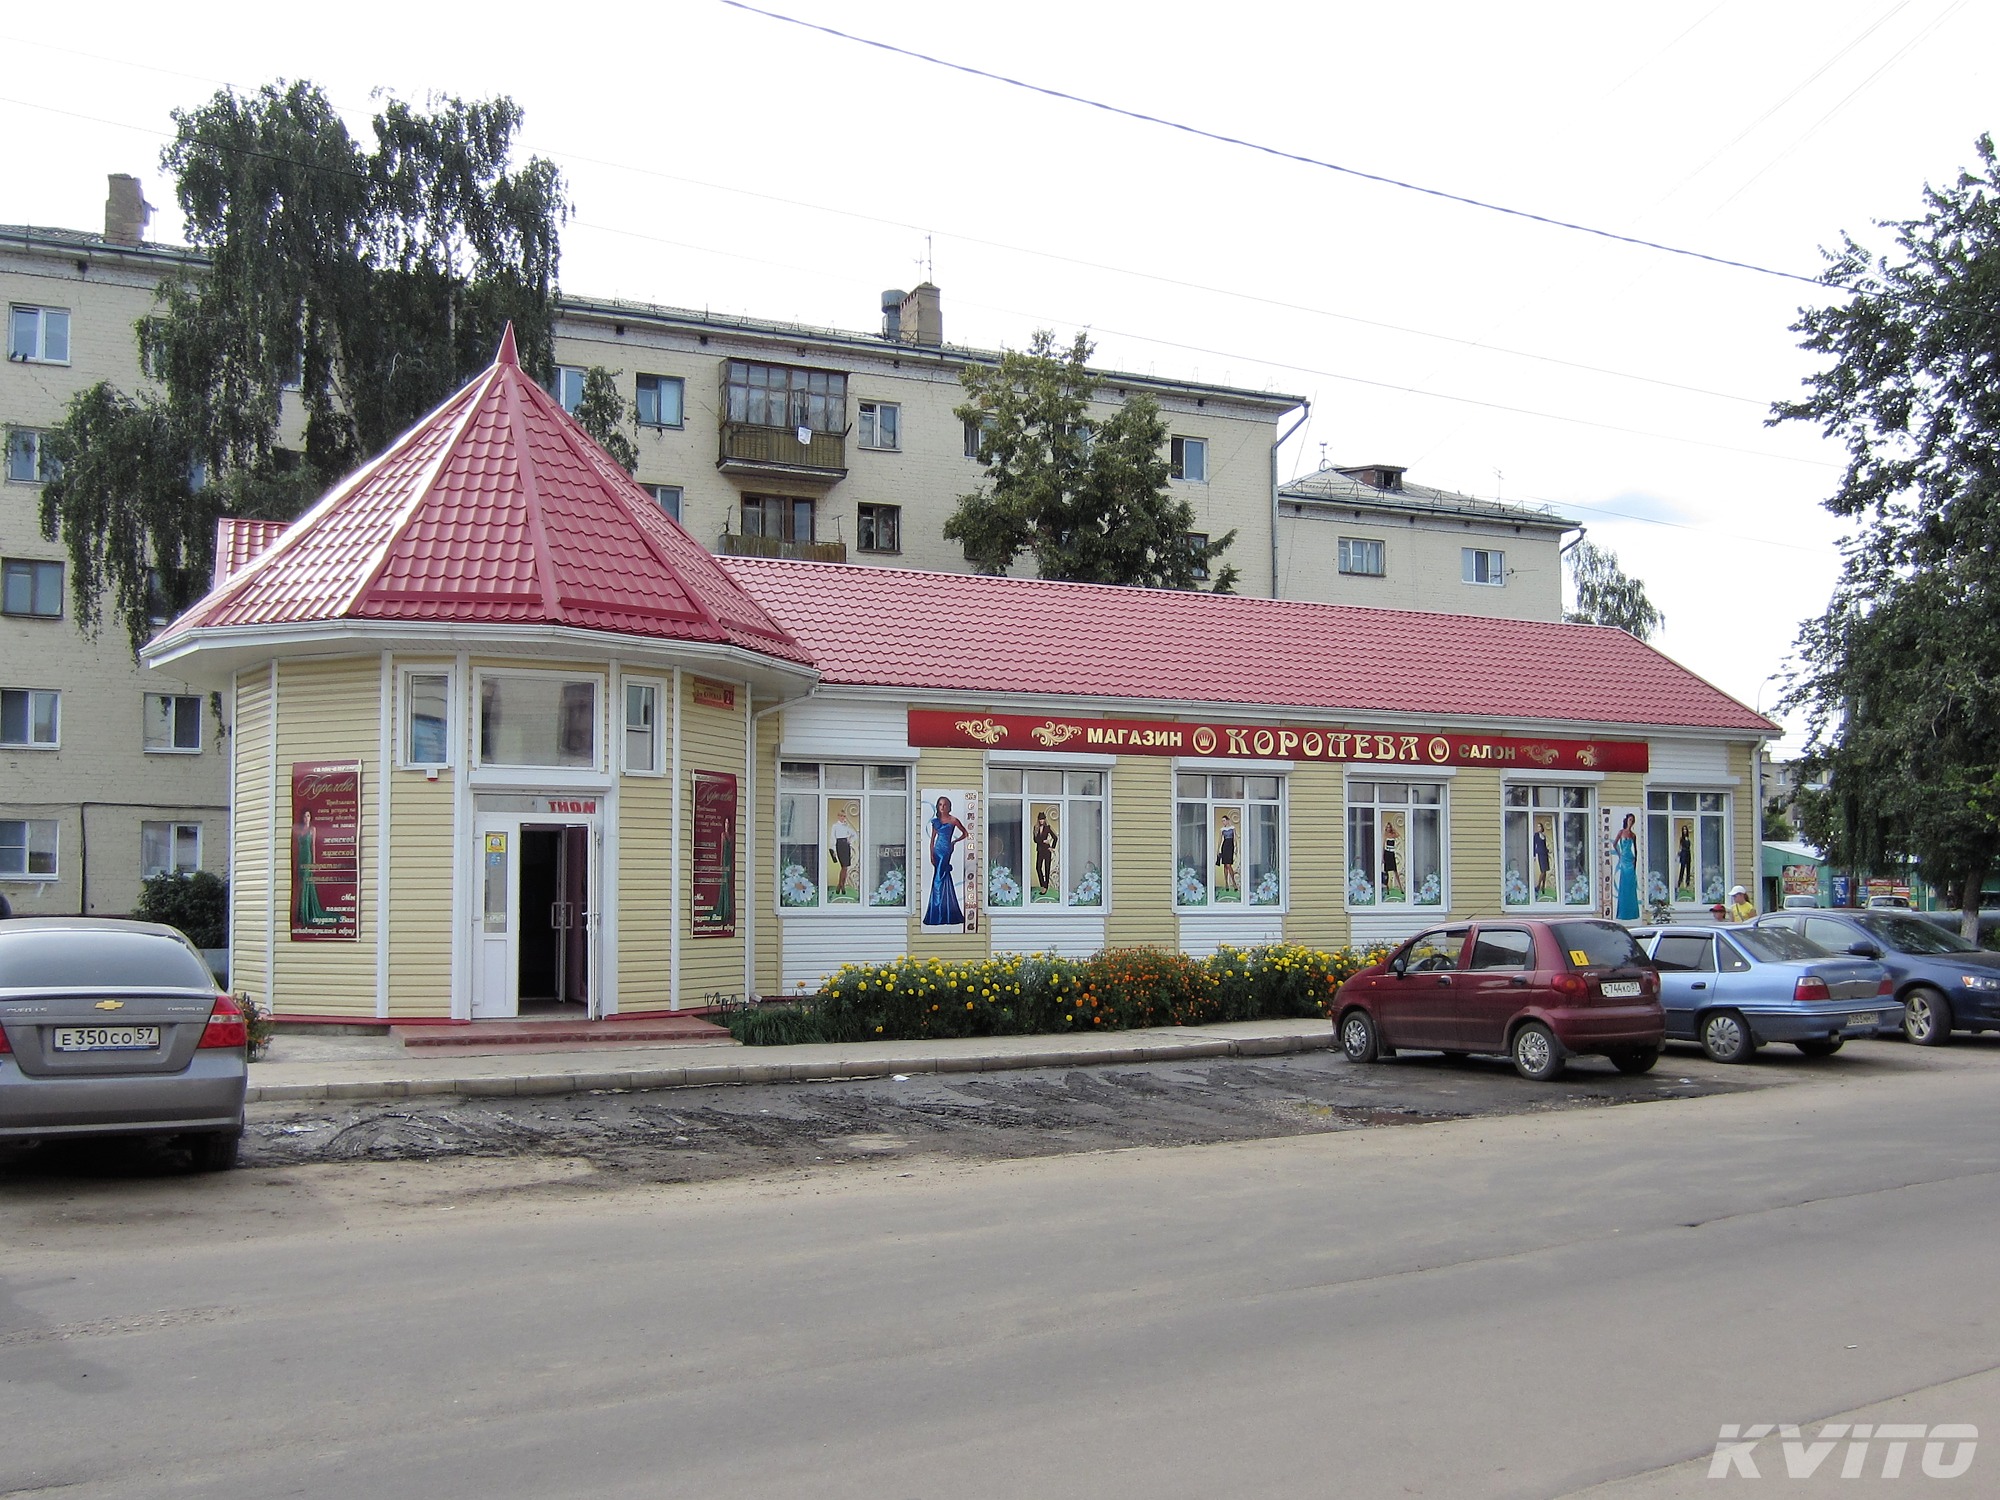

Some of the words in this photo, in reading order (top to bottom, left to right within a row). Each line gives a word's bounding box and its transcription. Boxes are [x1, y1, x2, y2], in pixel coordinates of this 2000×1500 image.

[1087, 728, 1182, 747] МАГАЗИН
[1226, 729, 1420, 761] КОРОЛЕВА
[1458, 744, 1516, 760] САЛОН
[323, 836, 355, 844] женской
[341, 893, 356, 901] Мы
[62, 1030, 132, 1046] Е350СО
[136, 1028, 153, 1040] 57
